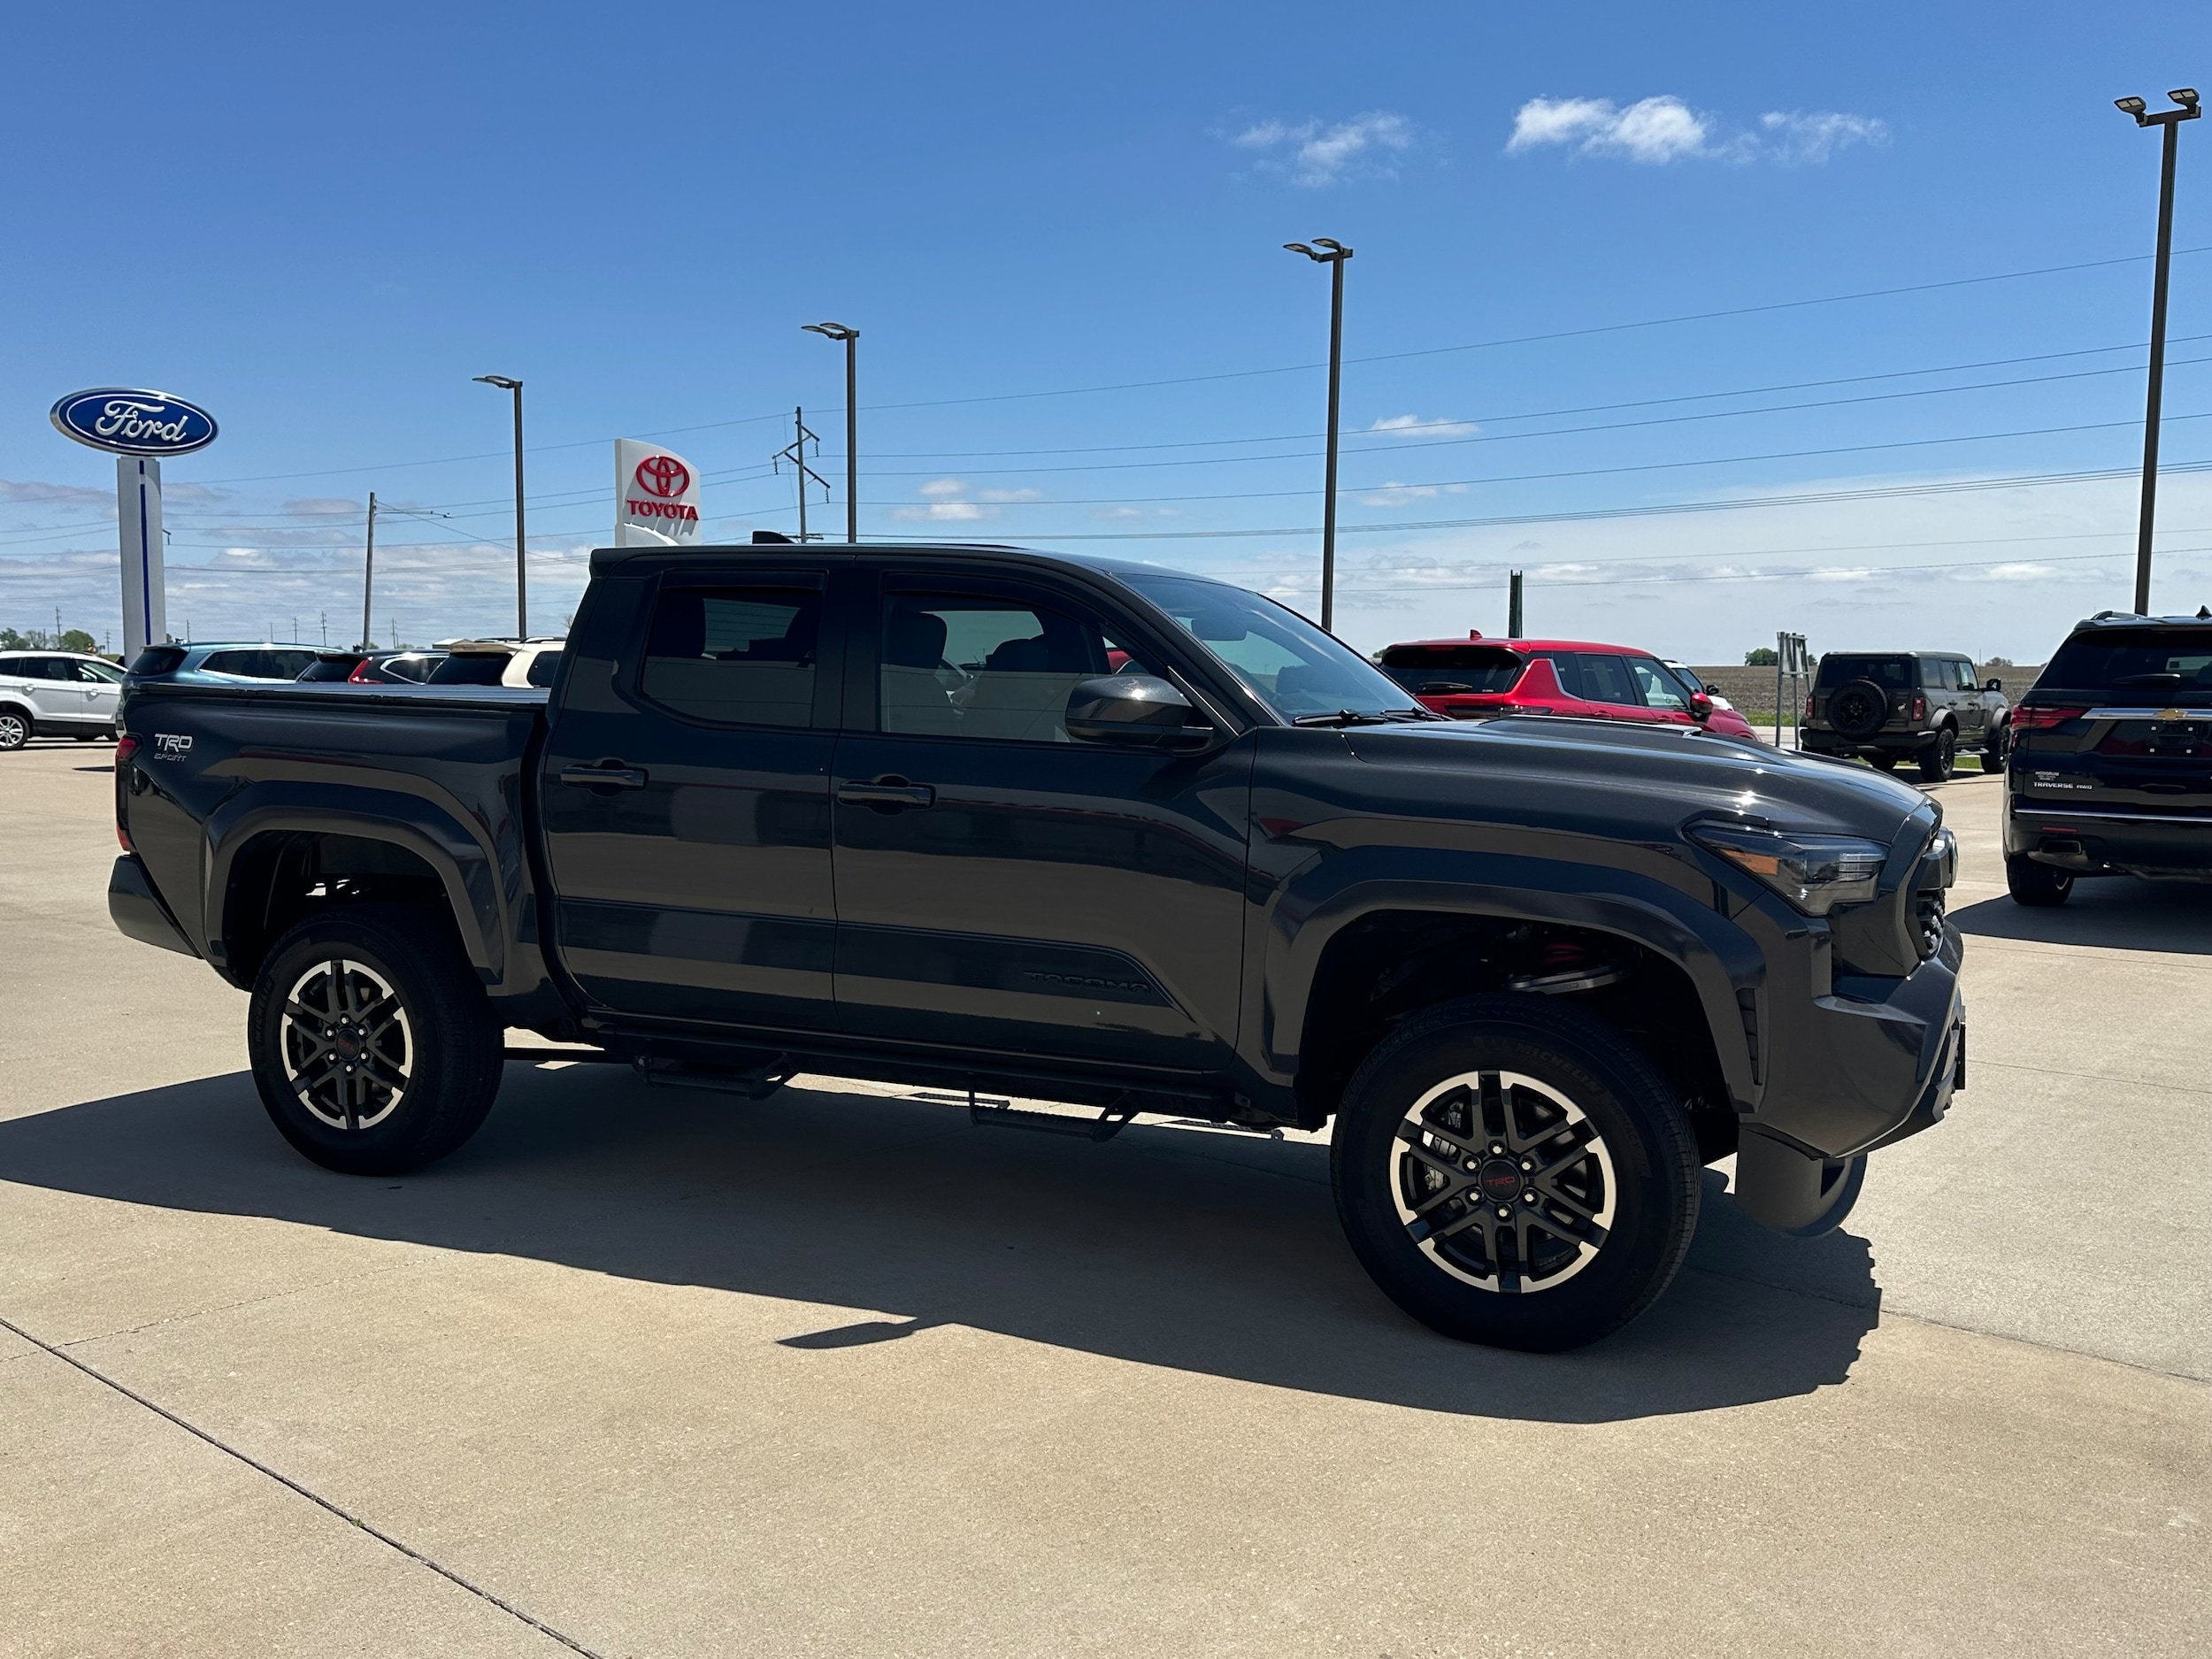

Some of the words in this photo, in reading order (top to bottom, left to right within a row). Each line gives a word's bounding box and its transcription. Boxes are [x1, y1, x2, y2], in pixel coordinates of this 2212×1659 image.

[95, 400, 188, 442] Ford
[626, 499, 699, 521] TOYOTA
[154, 733, 193, 753] TRD
[1023, 970, 1151, 994] TACOMA
[1516, 1041, 1603, 1094] MICHELIN
[1486, 1175, 1516, 1188] TRD
